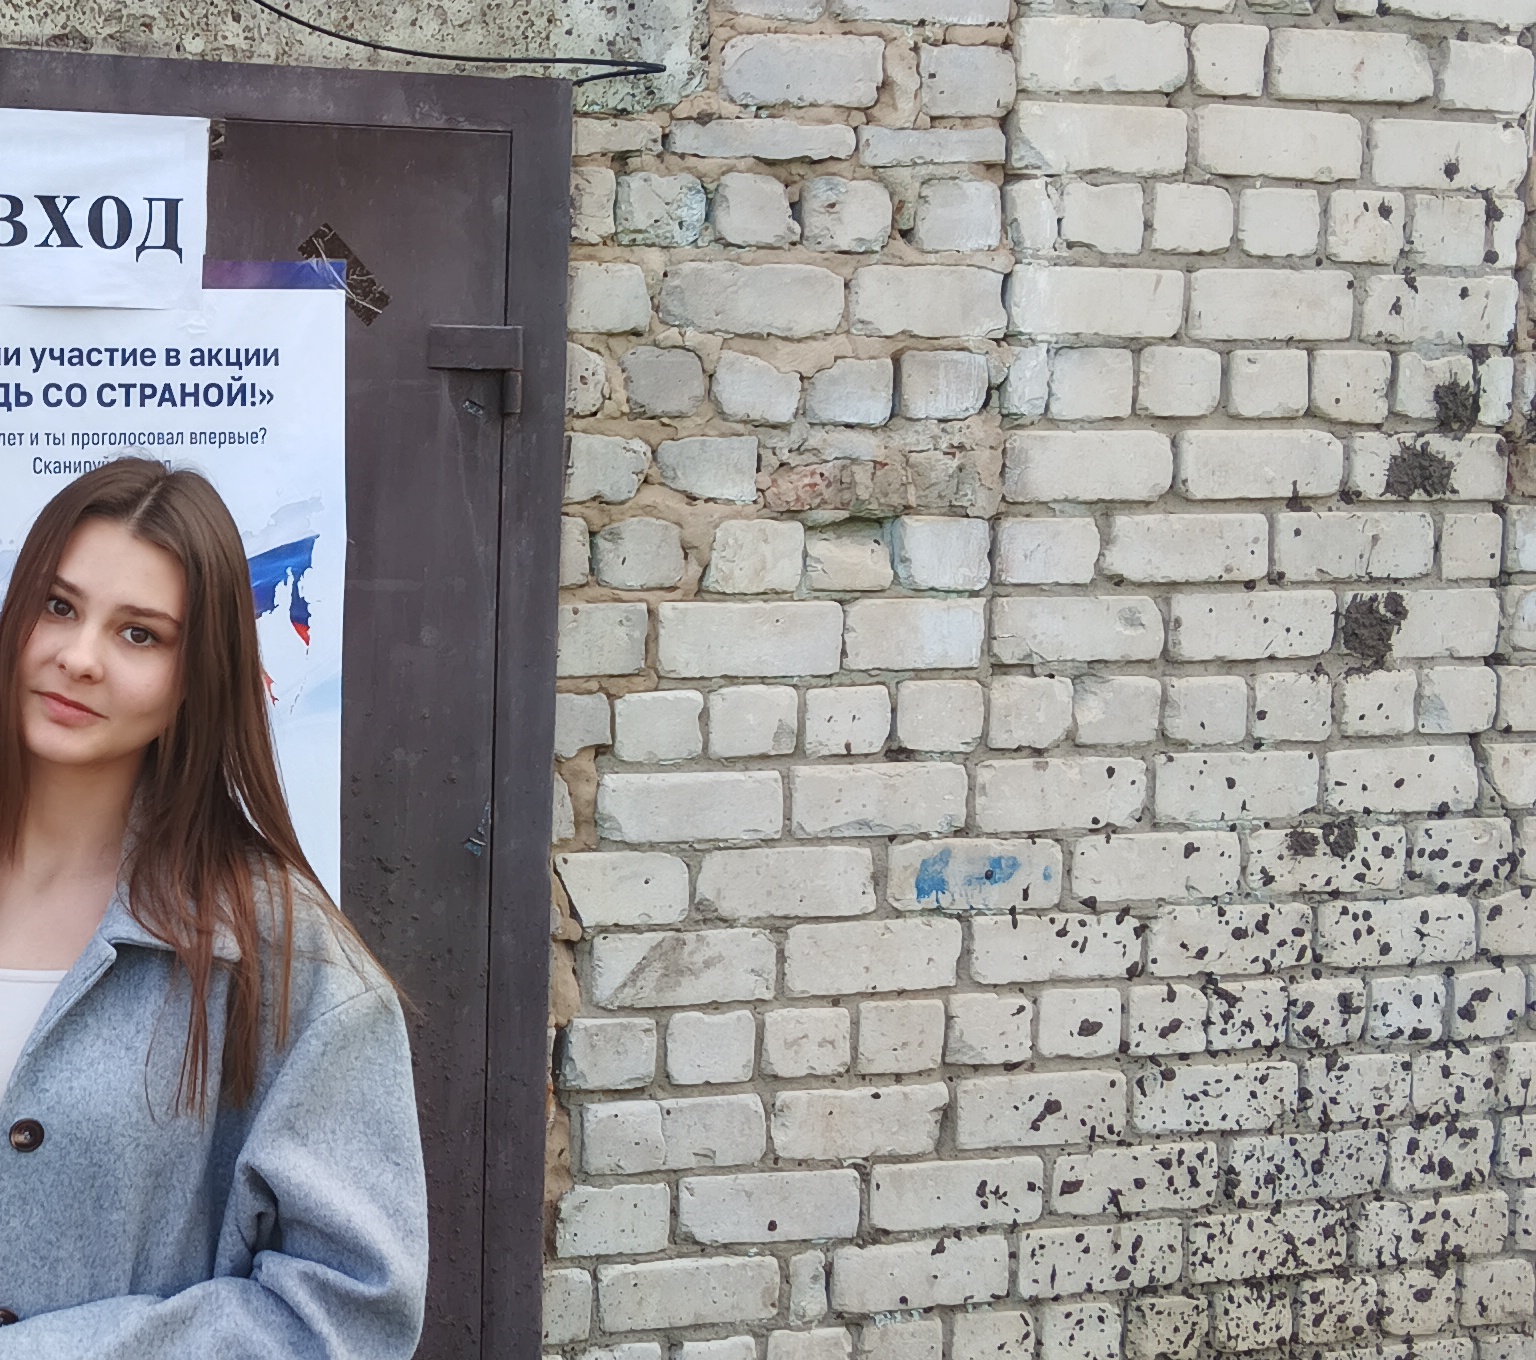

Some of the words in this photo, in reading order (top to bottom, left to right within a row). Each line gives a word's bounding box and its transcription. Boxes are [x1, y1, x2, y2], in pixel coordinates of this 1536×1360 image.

[29, 346, 157, 374] участие
[164, 347, 181, 367] в
[189, 347, 280, 371] акции
[42, 382, 88, 408] СО
[96, 375, 275, 408] СТРАНОЙ!»
[29, 432, 39, 446] и
[44, 432, 65, 446] ты
[71, 431, 184, 450] проголосовал
[189, 426, 267, 449] впервые?
